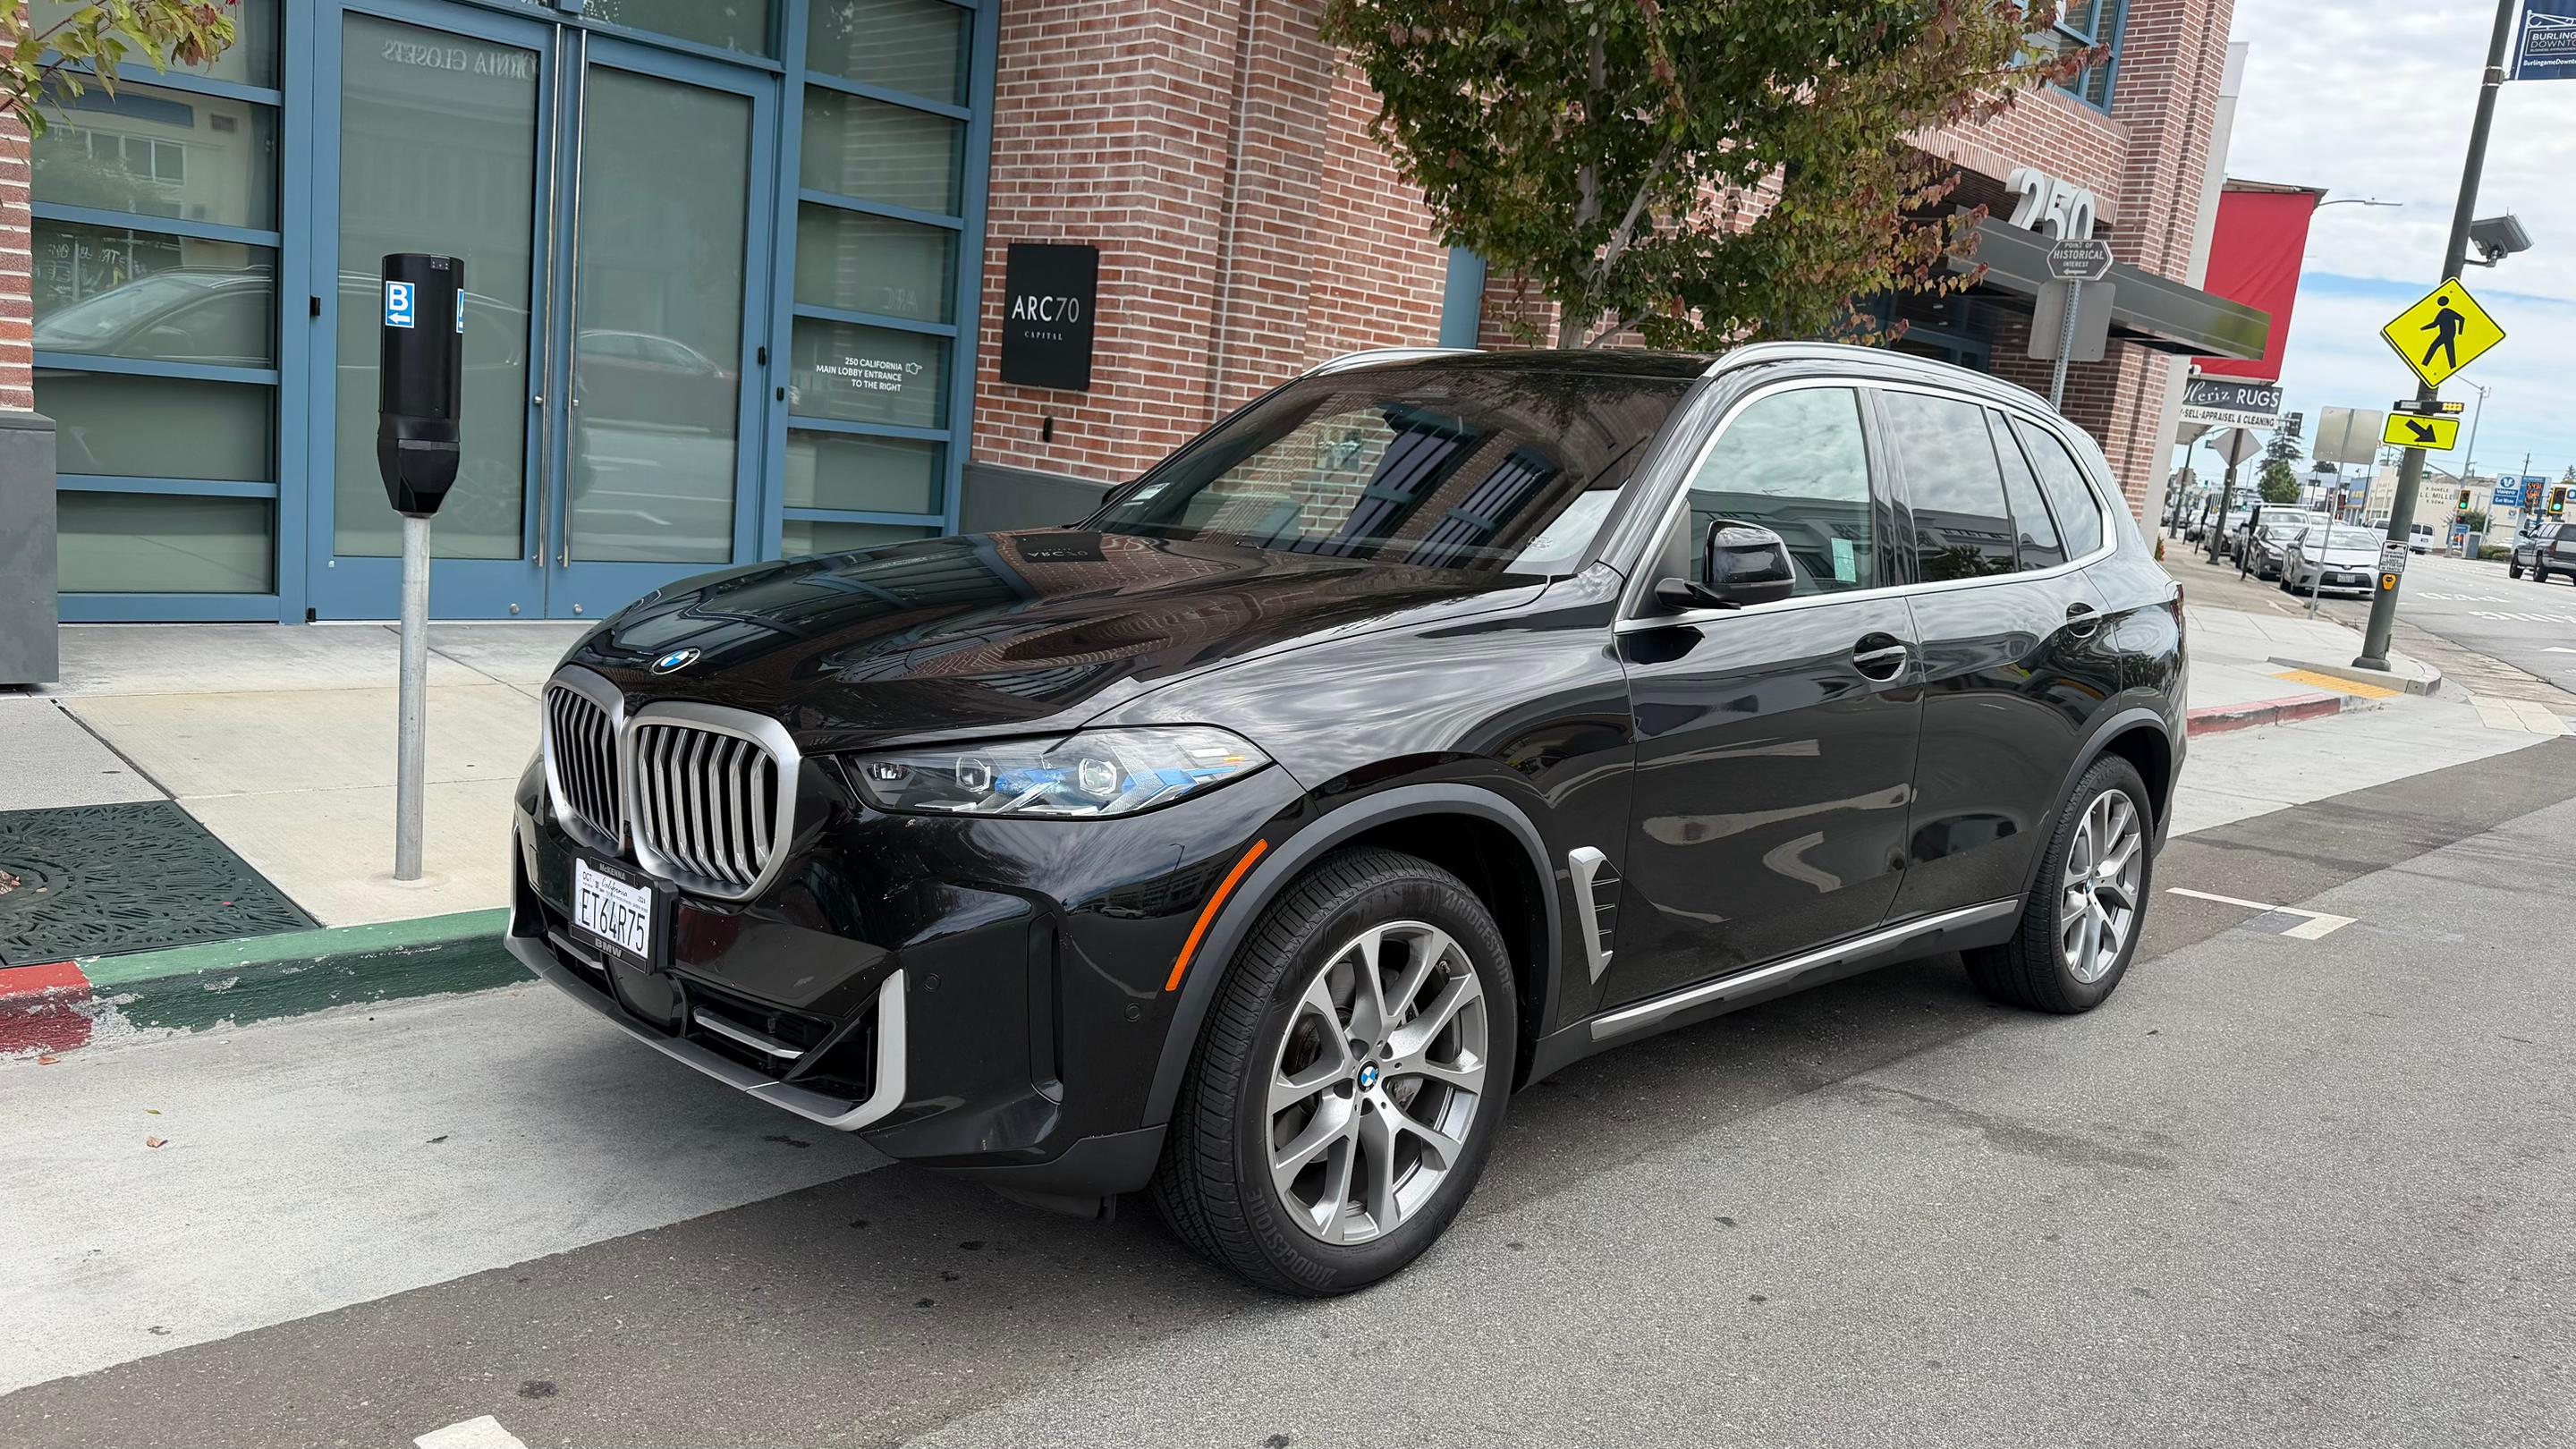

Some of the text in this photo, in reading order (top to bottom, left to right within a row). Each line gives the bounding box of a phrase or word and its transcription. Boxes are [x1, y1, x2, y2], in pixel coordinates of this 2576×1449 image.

[2006, 168, 2095, 241] 250
[2053, 250, 2104, 260] HISTORICAL
[389, 284, 409, 311] B
[1011, 294, 1080, 323] ARC70
[1024, 330, 1063, 341] CAPITAL
[816, 364, 902, 382] MAIN LOBBY ENTRANCE
[845, 357, 903, 371] 250 CALIFORNIA
[852, 378, 902, 392] TO THE RIGHT
[2236, 388, 2280, 408] RUGS
[2242, 415, 2275, 427] CLEANING
[599, 862, 626, 881] McKENNA
[601, 877, 628, 897] California
[581, 887, 646, 953] ET64R75
[595, 937, 623, 958] BMW
